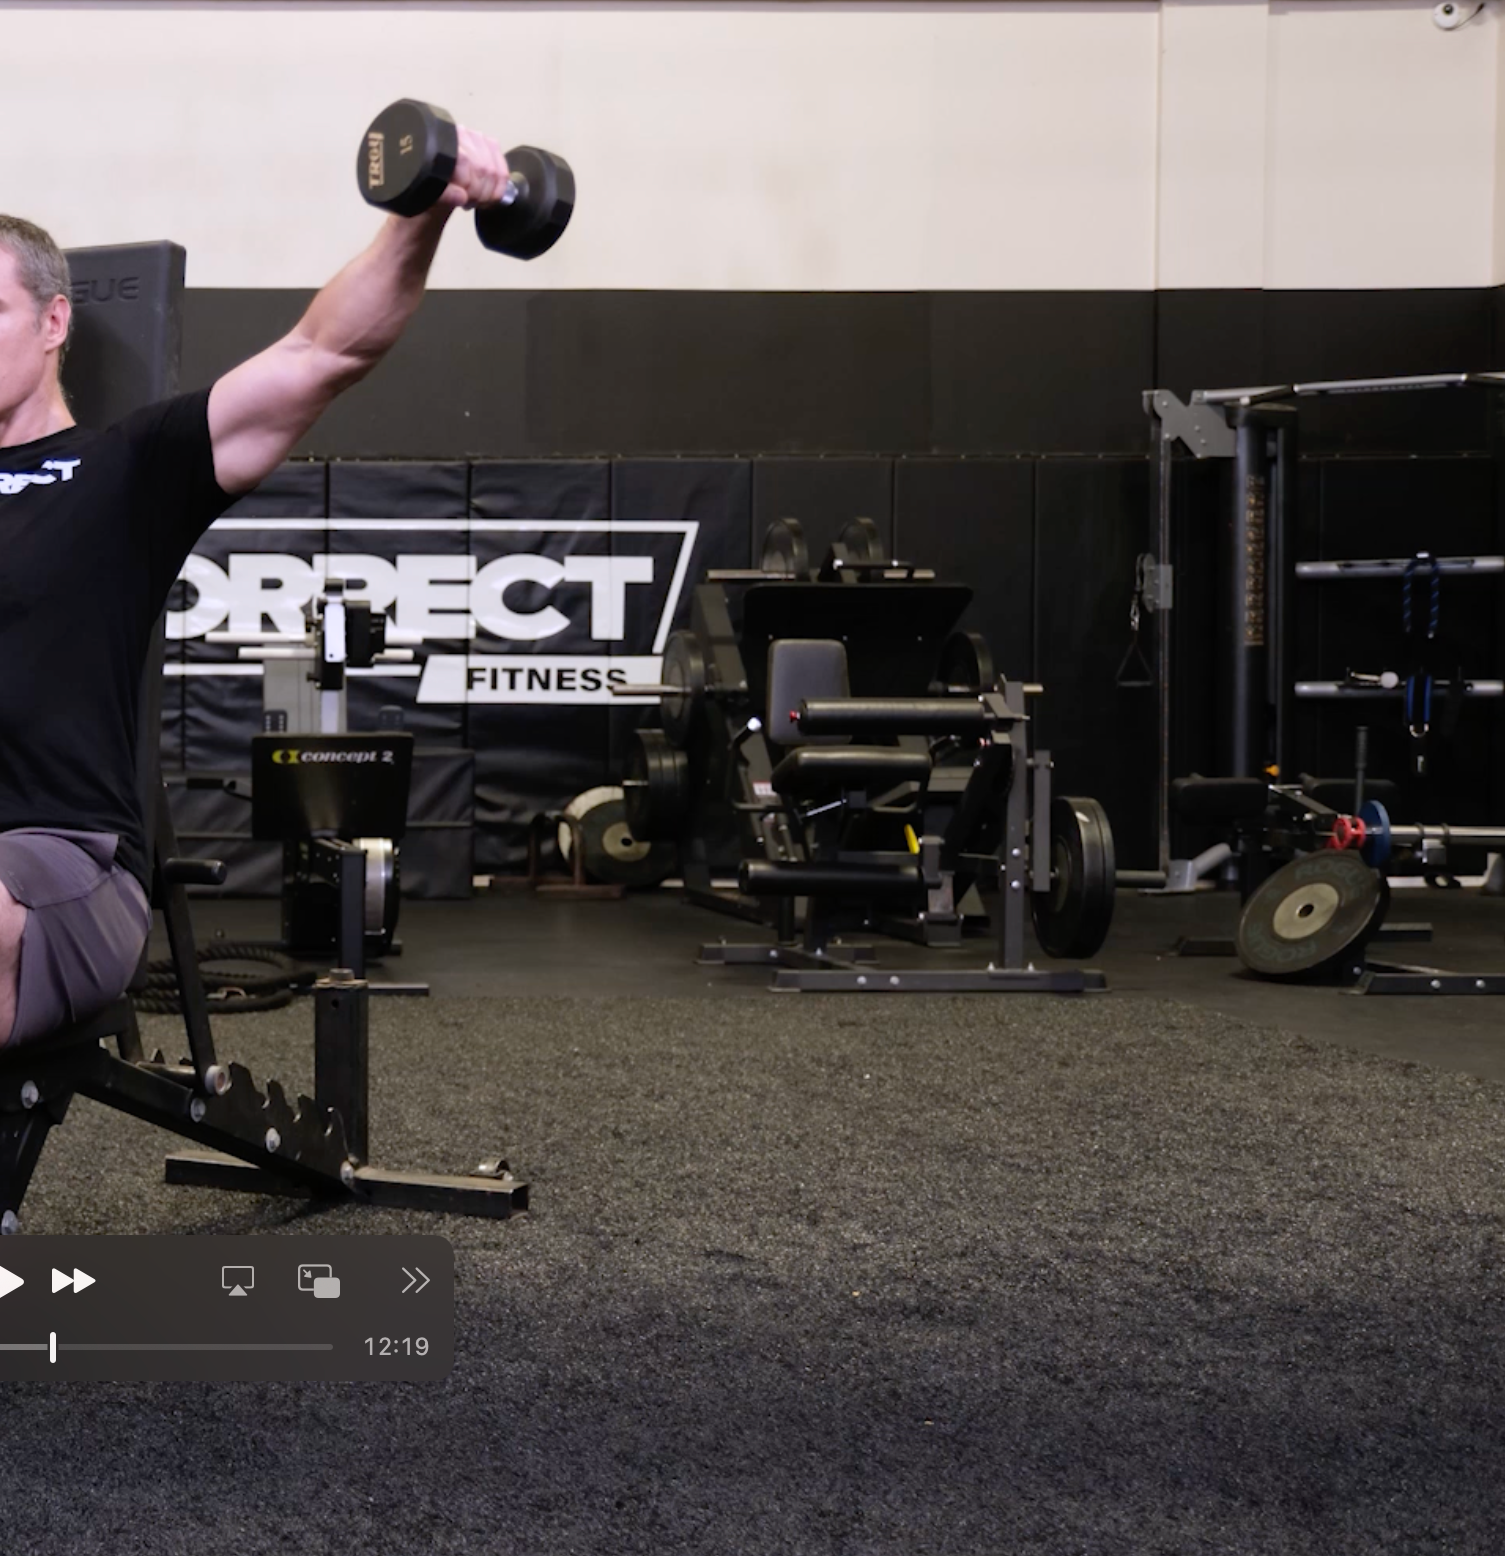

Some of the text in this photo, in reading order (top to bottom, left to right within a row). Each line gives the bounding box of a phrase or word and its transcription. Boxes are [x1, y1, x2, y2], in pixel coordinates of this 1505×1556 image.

[399, 134, 414, 156] 15
[367, 131, 385, 190] TROY
[71, 276, 139, 304] GUE
[164, 553, 655, 640] ORRECT
[466, 667, 628, 692] FITNESS
[300, 750, 377, 764] concept
